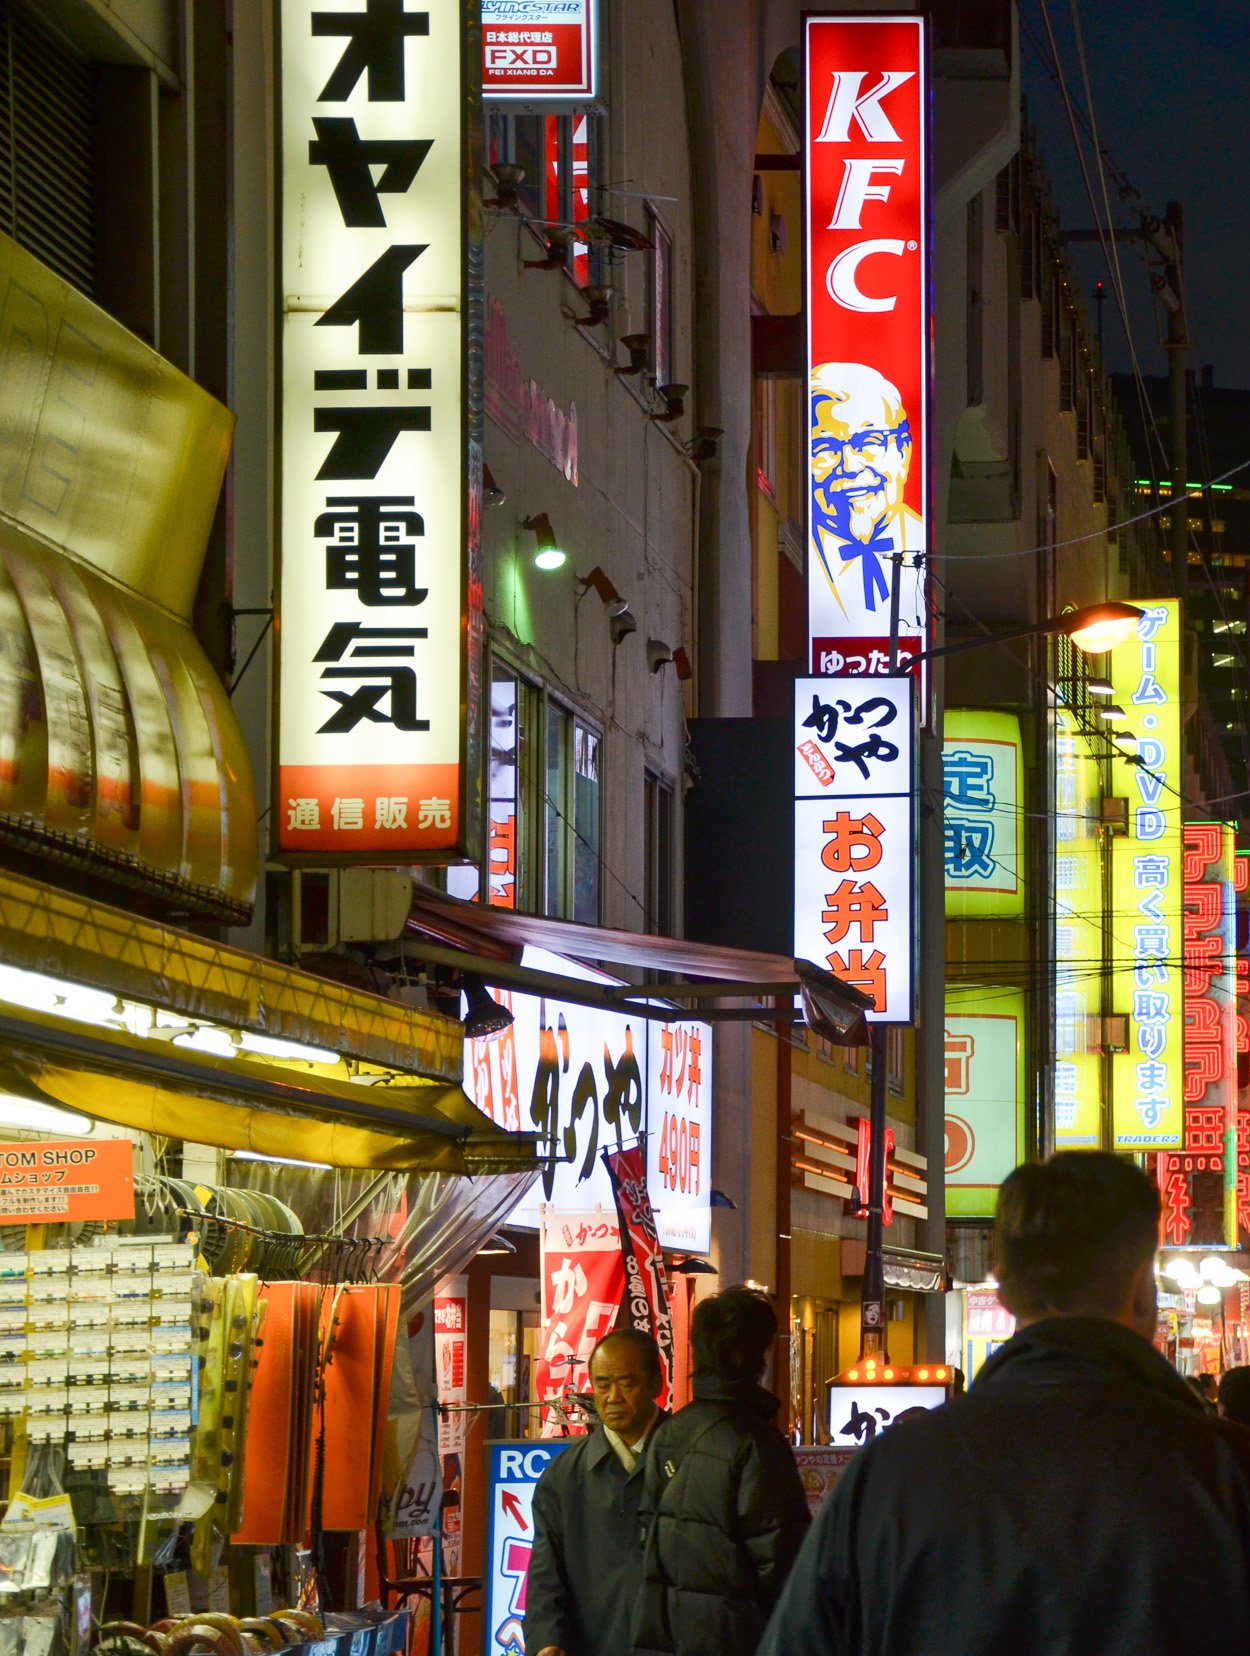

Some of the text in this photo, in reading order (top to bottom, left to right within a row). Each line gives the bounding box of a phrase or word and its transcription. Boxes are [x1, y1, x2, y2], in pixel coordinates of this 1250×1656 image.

[490, 49, 552, 65] FXD
[813, 71, 917, 313] KFC
[307, 0, 435, 734] オヤイデ電気
[287, 796, 453, 832] 通信販売
[1132, 855, 1171, 1130] 高く買い取ります
[529, 998, 644, 1201] かつや
[660, 1024, 702, 1108] カツ丼
[43, 1149, 96, 1165] SHOP
[658, 1111, 702, 1197] 490円
